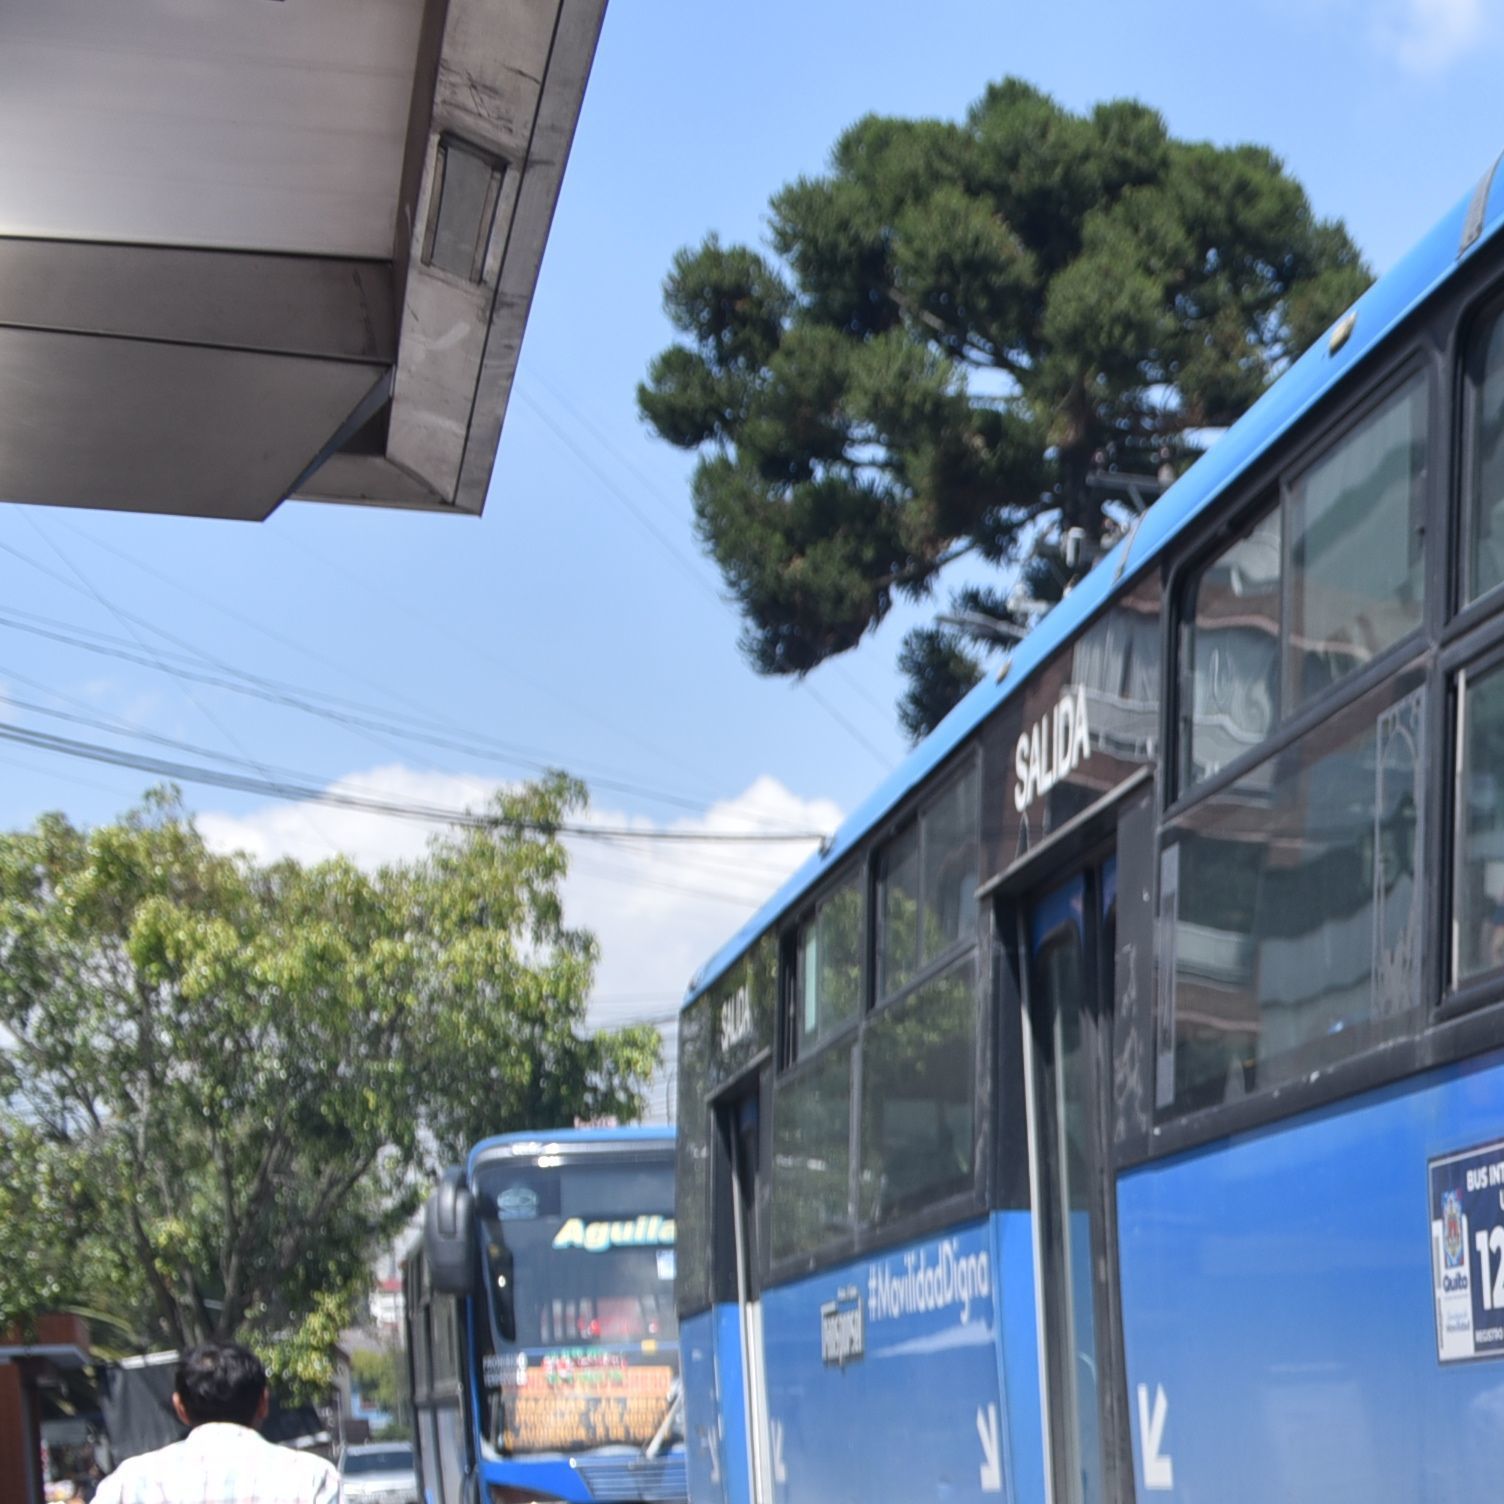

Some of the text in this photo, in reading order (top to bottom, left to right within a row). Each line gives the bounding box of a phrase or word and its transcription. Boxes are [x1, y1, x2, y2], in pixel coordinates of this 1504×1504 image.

[1014, 682, 1092, 813] SALIDA
[1467, 1167, 1488, 1192] BUS
[1442, 1272, 1469, 1293] Quito
[1475, 1327, 1501, 1344] REGISTRO
